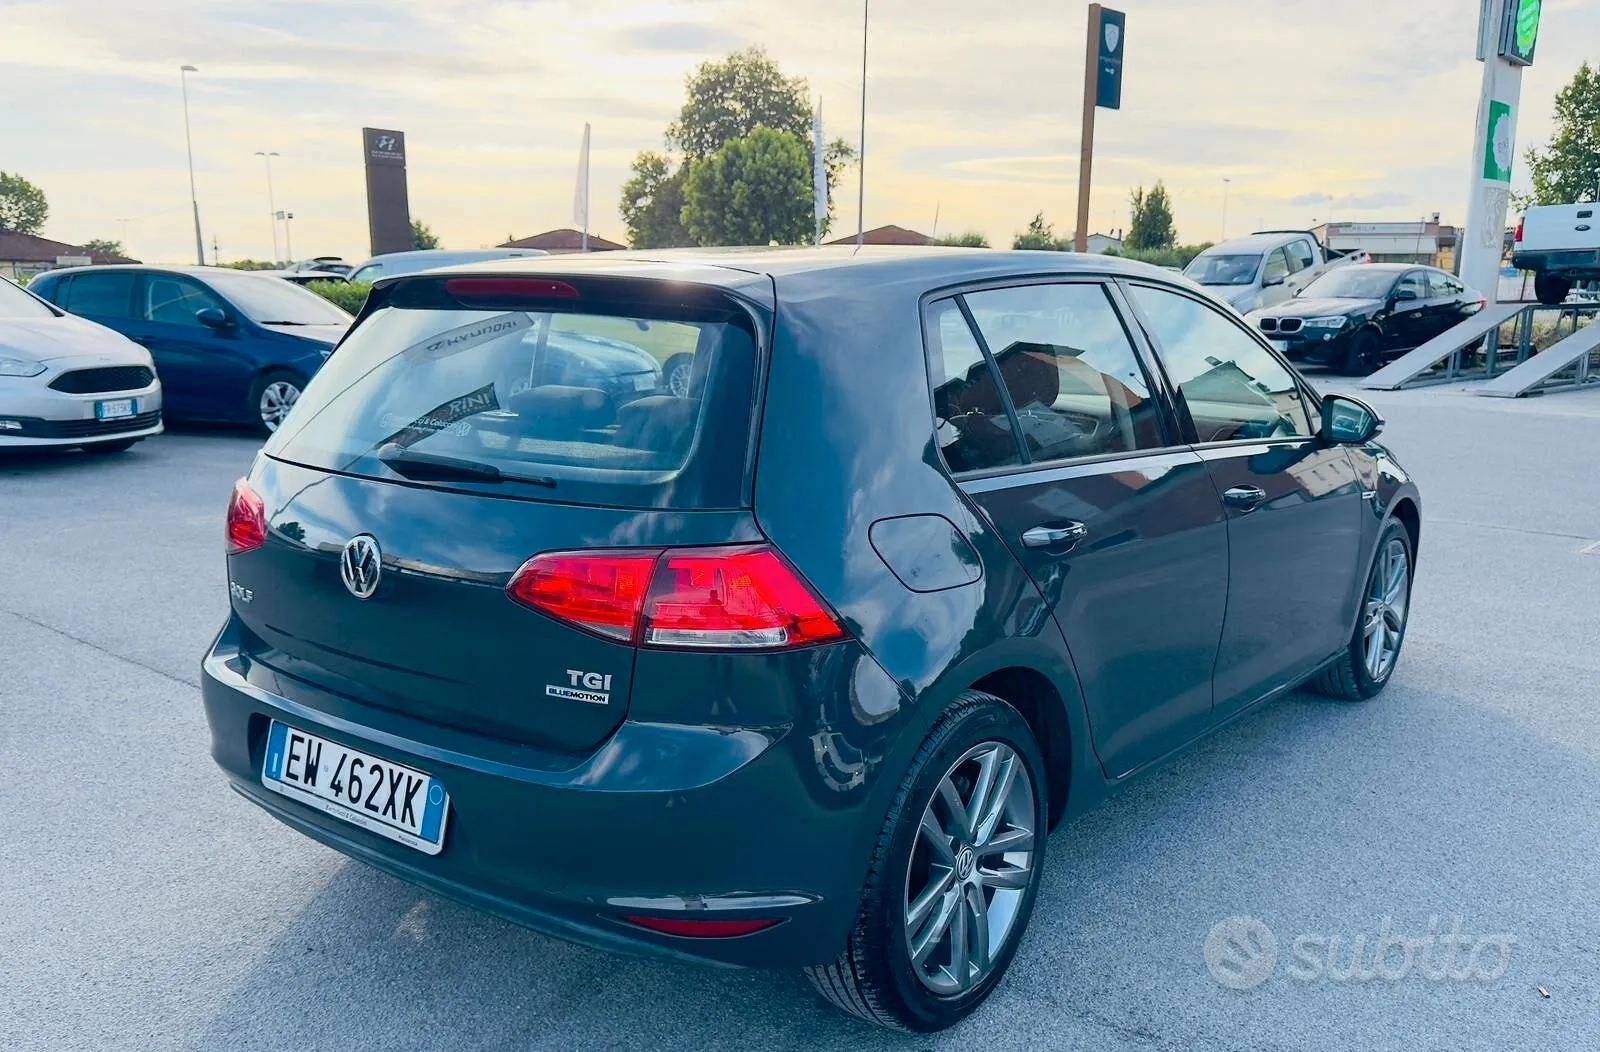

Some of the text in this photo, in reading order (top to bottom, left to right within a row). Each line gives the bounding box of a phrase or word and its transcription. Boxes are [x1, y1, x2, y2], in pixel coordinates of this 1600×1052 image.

[448, 320, 518, 347] HYUNDAI
[566, 668, 612, 691] TGI
[548, 687, 606, 702] BLUEMOTION
[285, 733, 424, 828] EW 462XK
